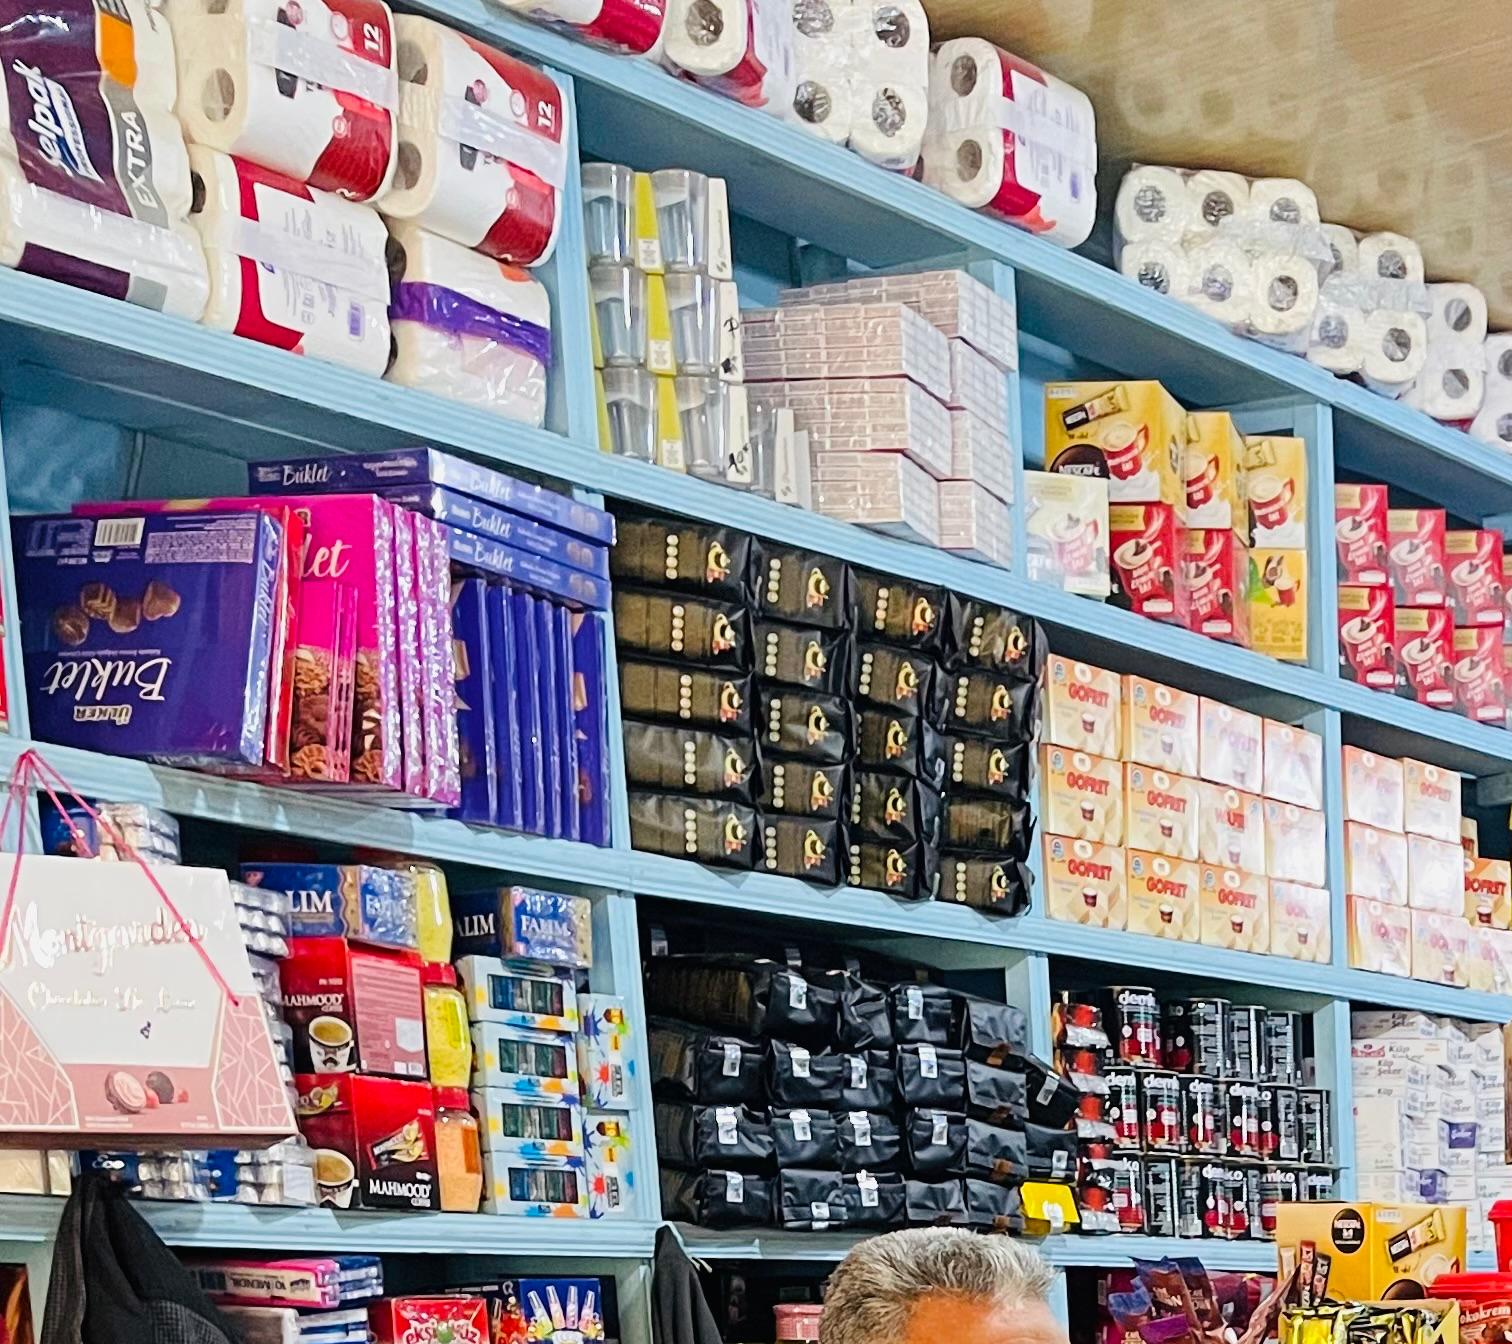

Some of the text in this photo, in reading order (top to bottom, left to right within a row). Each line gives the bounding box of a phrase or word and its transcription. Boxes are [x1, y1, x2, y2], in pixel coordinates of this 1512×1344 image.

[362, 22, 384, 54] 12
[536, 99, 557, 130] 12
[119, 111, 159, 210] EXTRA
[369, 1177, 433, 1201] MAHMOOD
